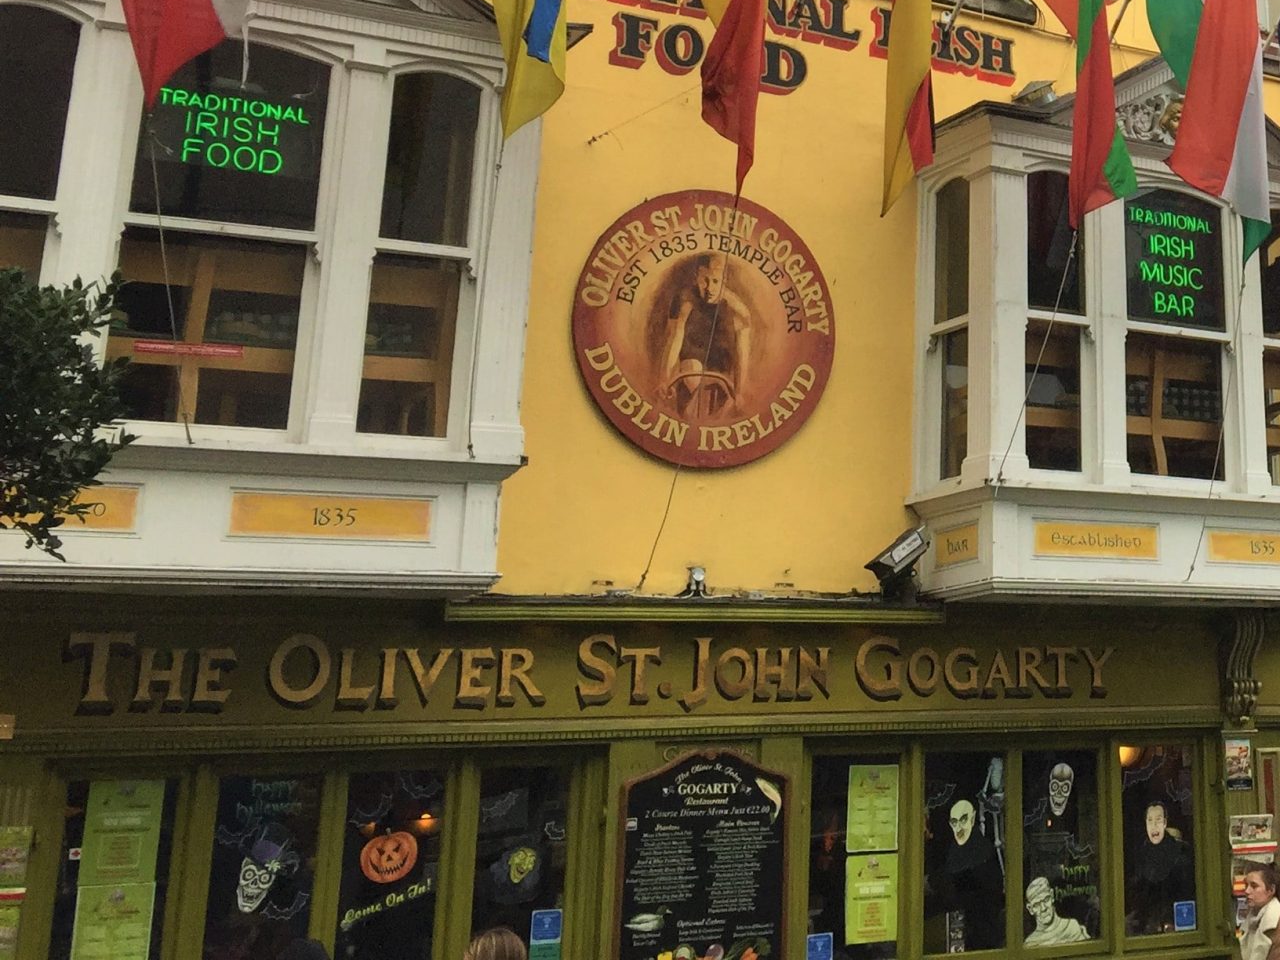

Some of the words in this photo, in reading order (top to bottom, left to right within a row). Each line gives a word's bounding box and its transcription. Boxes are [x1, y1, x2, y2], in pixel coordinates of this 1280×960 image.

[609, 12, 808, 96] FOD
[869, 6, 1016, 87] IISH
[160, 88, 310, 125] TRADITIONAL
[184, 110, 281, 146] IRISH
[181, 138, 284, 174] FOOD
[1128, 206, 1213, 235] TRADITIONAL
[1148, 234, 1195, 260] IRISH
[581, 218, 653, 308] OLIVER
[650, 205, 682, 238] ST
[689, 203, 758, 239] JOHN
[758, 228, 830, 336] GOGARTY
[616, 260, 648, 305] EST
[648, 232, 698, 265] 1835
[704, 233, 784, 286] TEMPLE
[779, 288, 803, 334] BAR
[1139, 261, 1205, 290] MUSIC
[1153, 291, 1196, 317] BAR
[584, 343, 690, 447] DUBLIN
[697, 363, 816, 451] IRELAND
[312, 506, 359, 528] 1835
[1250, 540, 1276, 555] 1835
[62, 631, 238, 716] THE
[267, 633, 547, 713] OLIVER
[854, 635, 1116, 702] GOGARTY
[677, 783, 739, 796] GOGARTY
[651, 808, 678, 819] Course
[679, 807, 706, 818] Dinner
[385, 892, 405, 907] On
